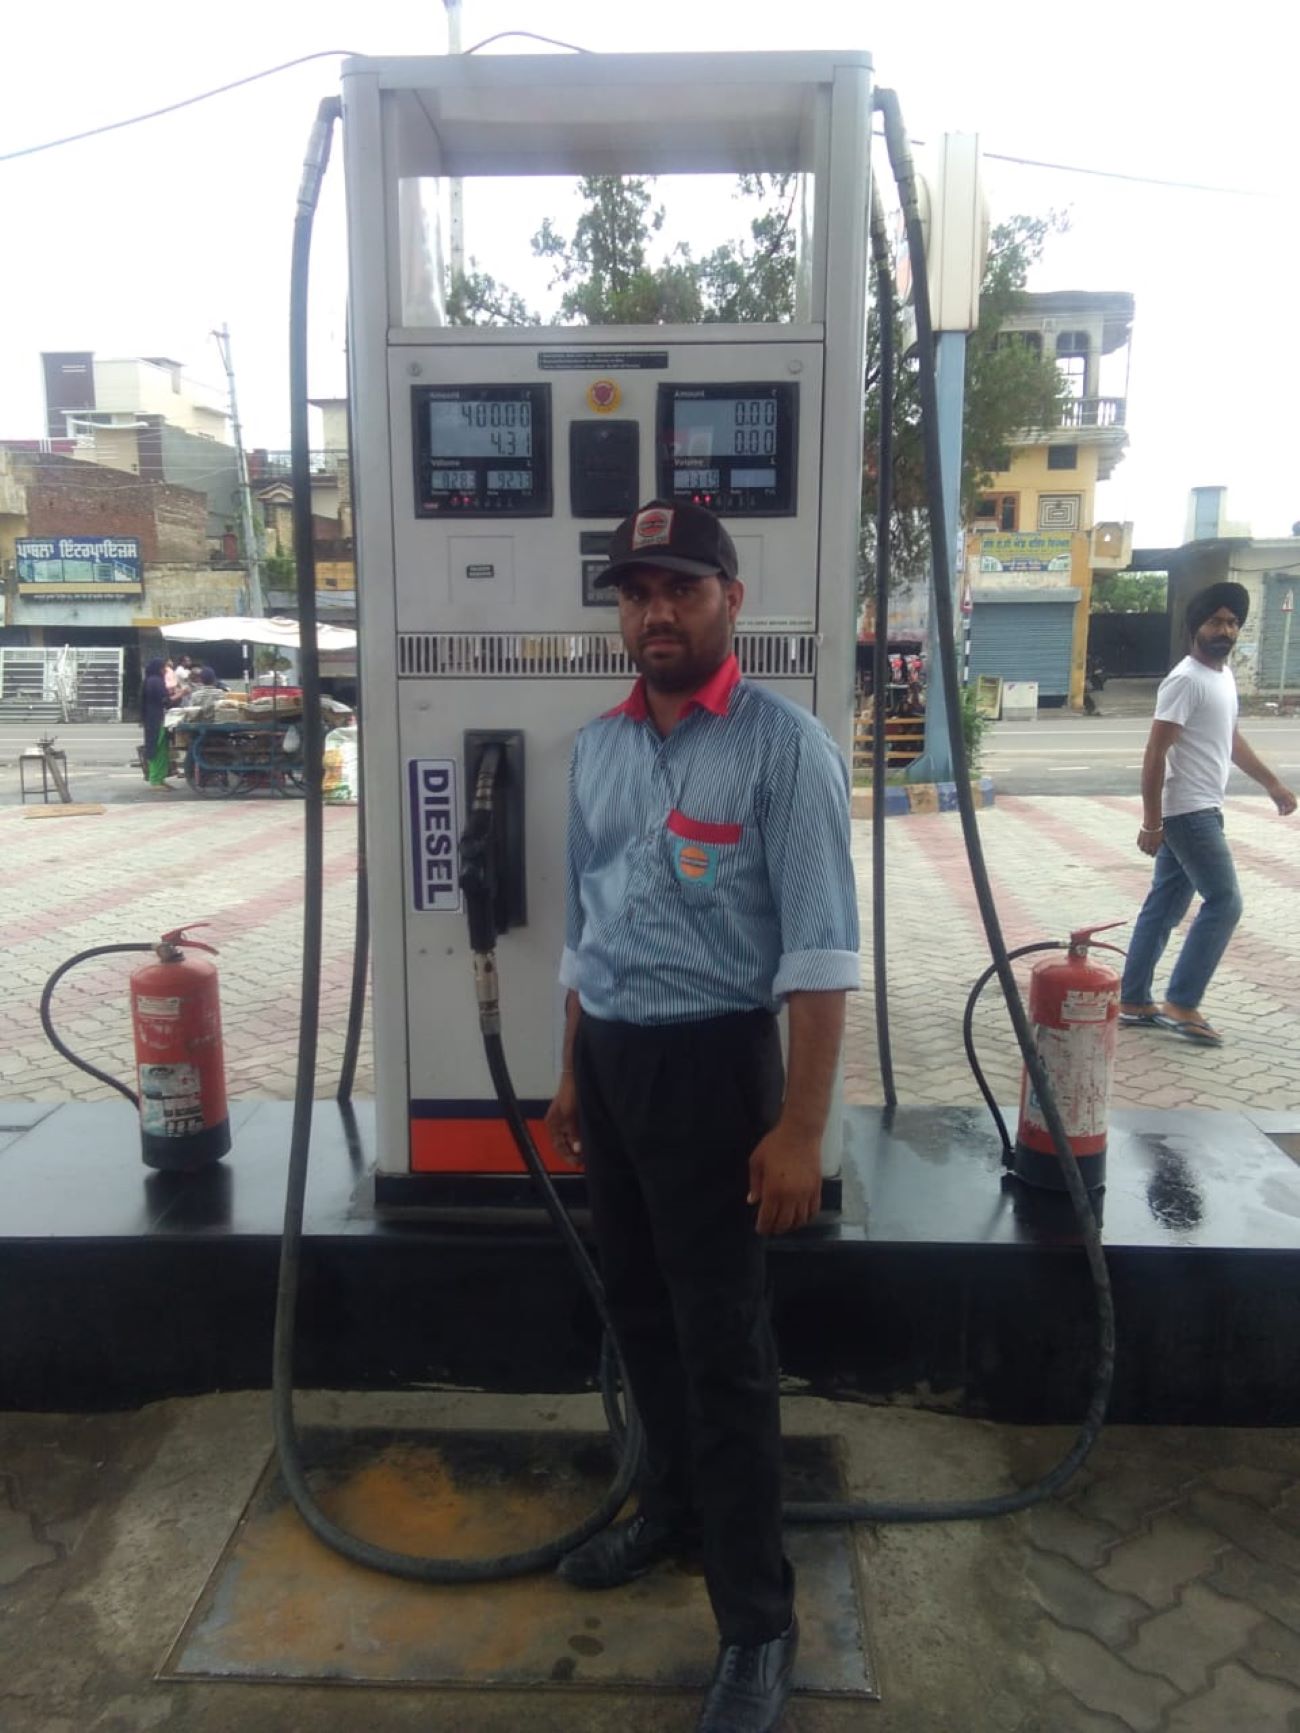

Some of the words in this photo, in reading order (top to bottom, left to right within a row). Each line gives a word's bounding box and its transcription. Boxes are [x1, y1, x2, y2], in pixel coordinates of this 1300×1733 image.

[461, 402, 530, 428] 400.00
[735, 401, 775, 426] 0.00
[491, 431, 531, 456] 4.31
[734, 429, 775, 454] 0.00
[423, 769, 453, 904] DIESEL
